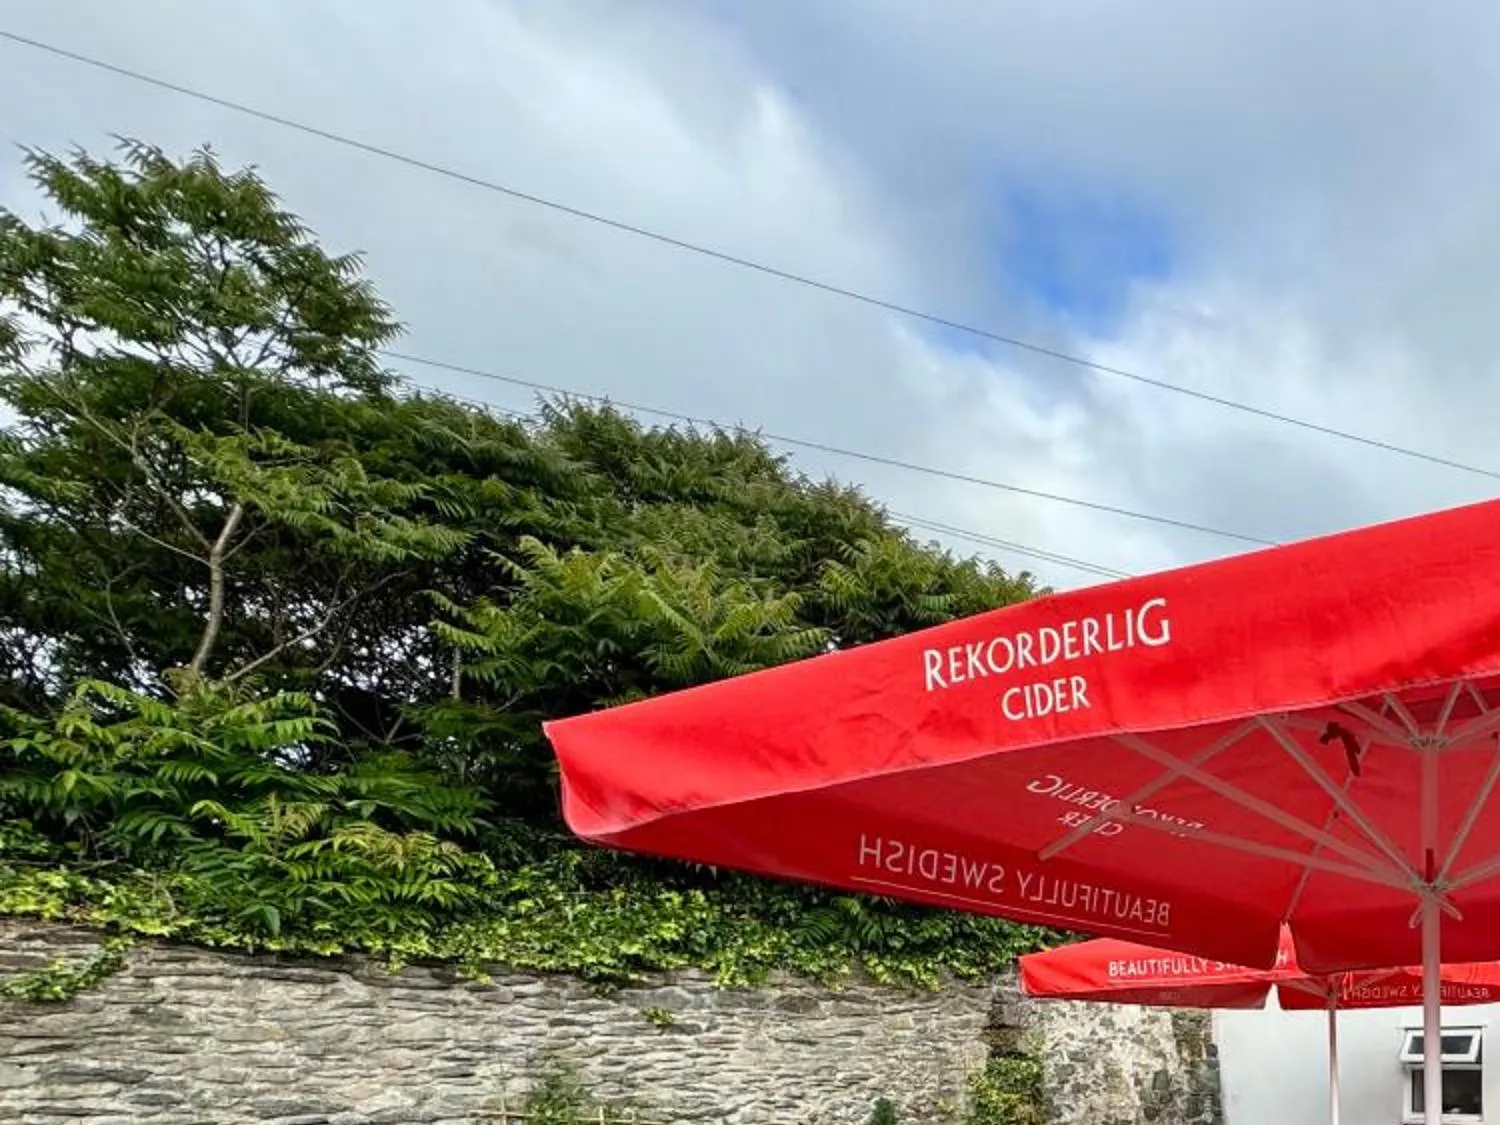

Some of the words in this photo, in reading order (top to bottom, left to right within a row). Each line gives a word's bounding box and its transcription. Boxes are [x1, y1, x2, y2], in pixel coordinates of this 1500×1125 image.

[924, 598, 1170, 691] REKORDERLIG
[1001, 675, 1091, 721] CIDER
[1108, 957, 1209, 978] BEAUTIFULLY
